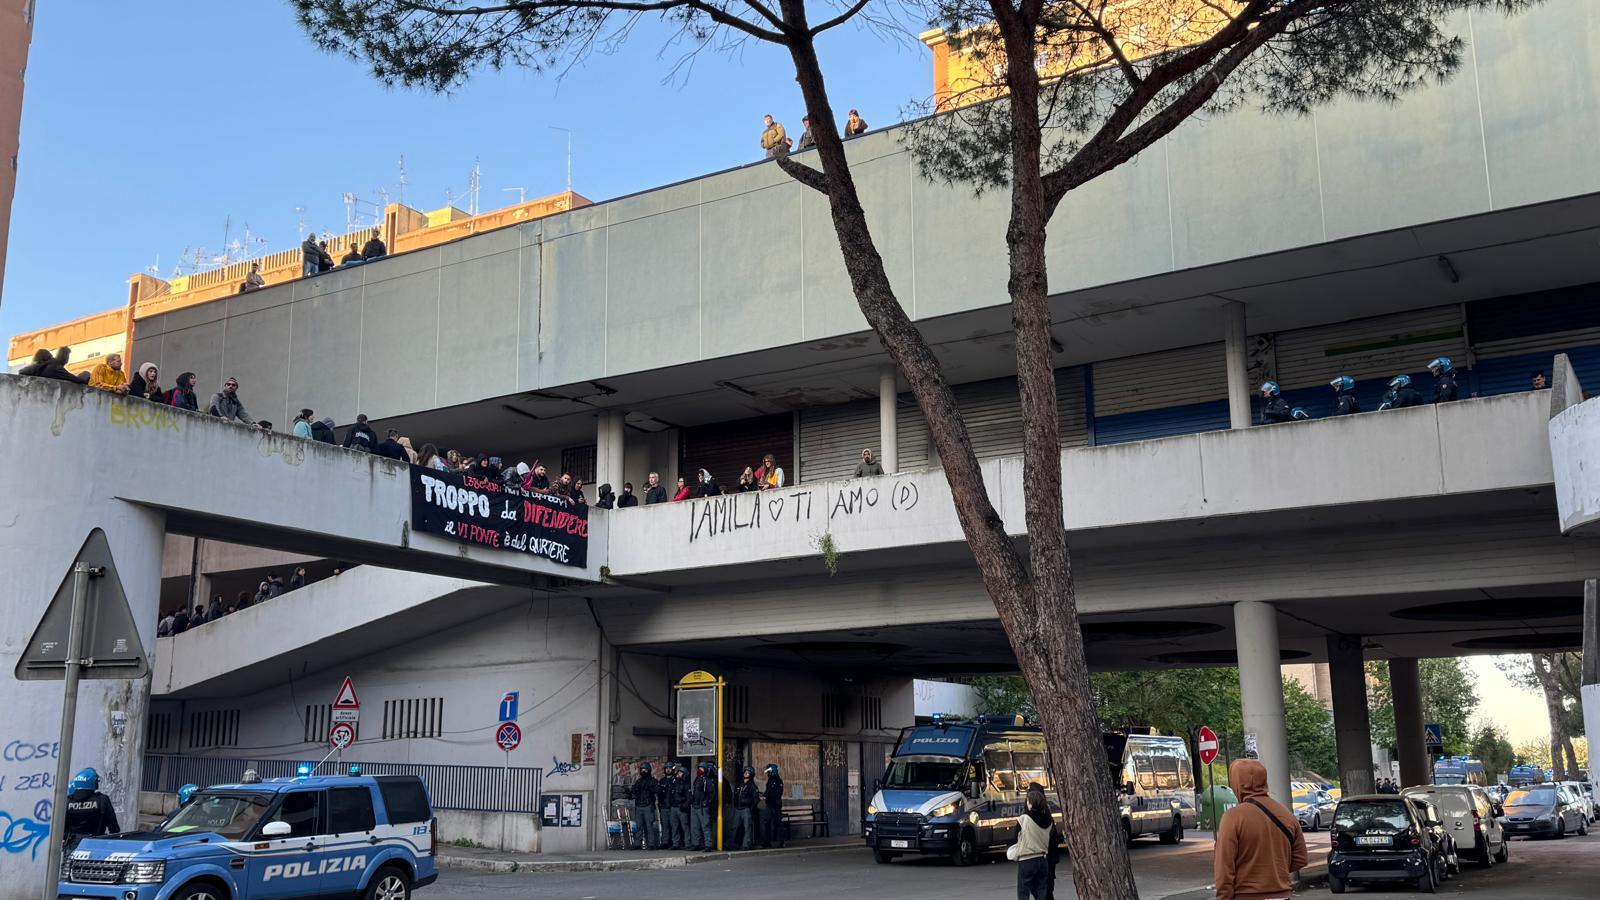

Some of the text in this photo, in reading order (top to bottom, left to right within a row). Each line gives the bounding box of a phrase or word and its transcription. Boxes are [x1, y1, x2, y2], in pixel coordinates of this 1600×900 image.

[111, 402, 180, 432] BRONX
[420, 474, 490, 518] TROPPO
[500, 499, 517, 521] da
[523, 500, 589, 538] DIFENDERE
[830, 486, 879, 519] AMO
[891, 480, 919, 512] (D)
[444, 520, 456, 535] il
[457, 521, 469, 539] VI
[469, 524, 500, 548] PONTE
[503, 530, 511, 547] è
[511, 533, 527, 551] del
[68, 800, 98, 811] POLIZIA
[413, 825, 428, 836] 113
[263, 854, 367, 882] POLIZIA
